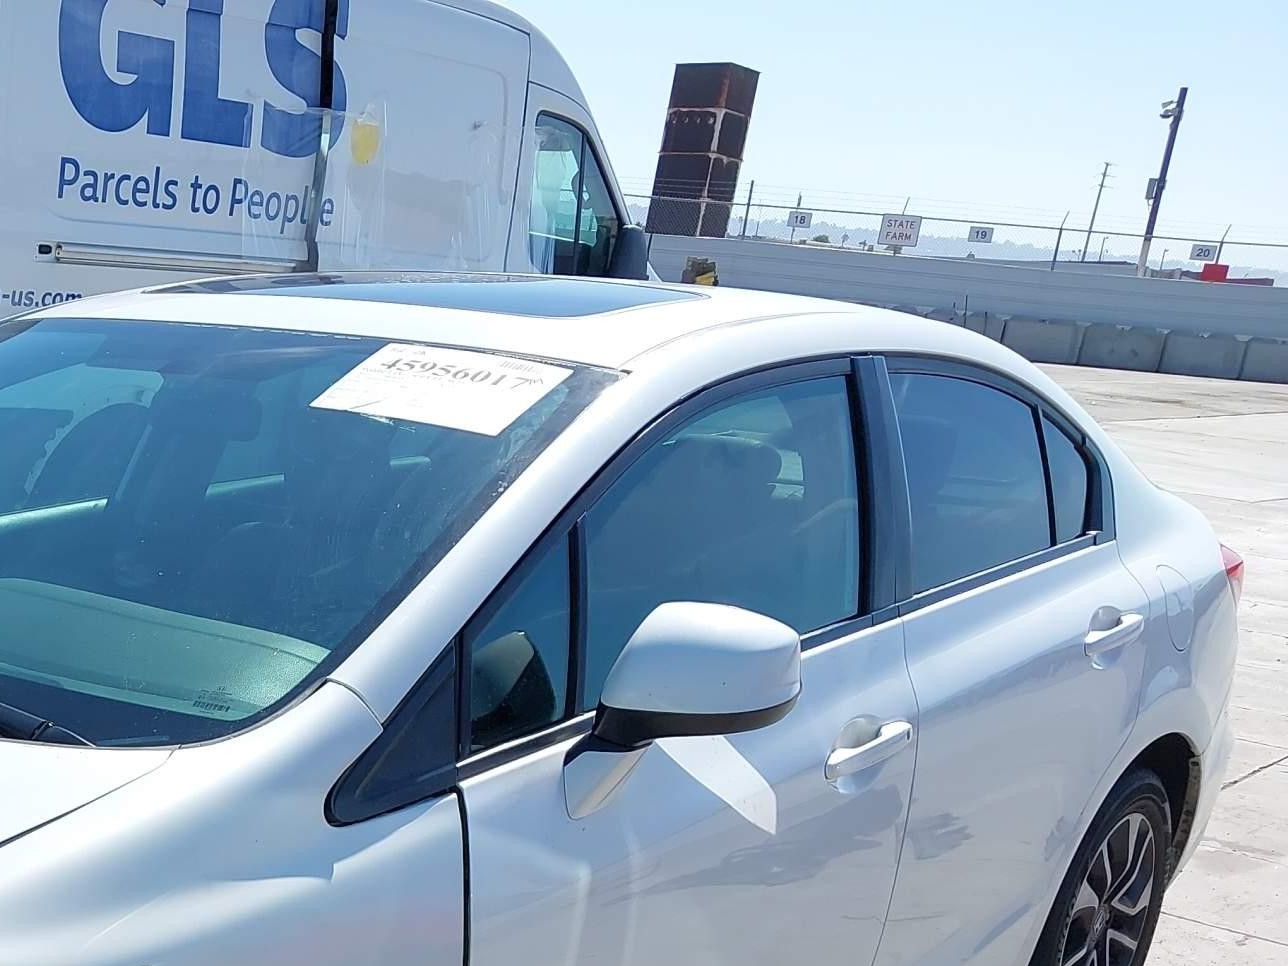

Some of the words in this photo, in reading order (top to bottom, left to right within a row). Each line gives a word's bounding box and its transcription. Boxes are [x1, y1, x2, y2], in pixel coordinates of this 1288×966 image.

[57, 155, 180, 211] Parcels
[190, 174, 221, 217] to
[228, 177, 336, 235] People
[794, 215, 806, 225] 18
[886, 219, 917, 230] STATE
[885, 231, 912, 242] FARM
[974, 230, 987, 240] 19
[1196, 248, 1210, 258] 20
[380, 358, 531, 390] 45956017
